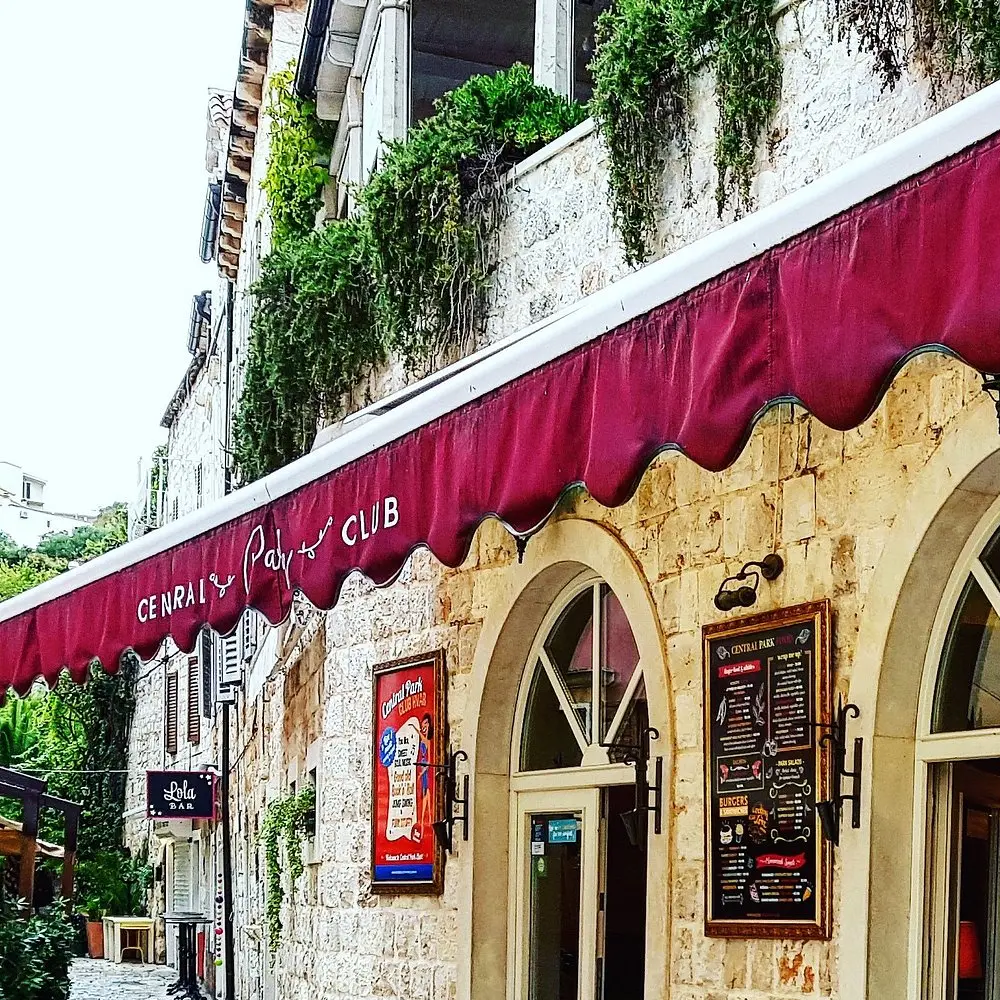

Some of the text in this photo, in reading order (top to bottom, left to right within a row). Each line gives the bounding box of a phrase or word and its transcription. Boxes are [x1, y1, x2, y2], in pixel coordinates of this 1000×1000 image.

[341, 497, 400, 546] CLUB
[731, 641, 759, 655] CENTRAL
[758, 637, 775, 650] PARK
[381, 676, 423, 719] Central Park
[163, 779, 196, 802] Lola
[168, 802, 195, 810] BAR
[719, 795, 748, 807] BURGERS
